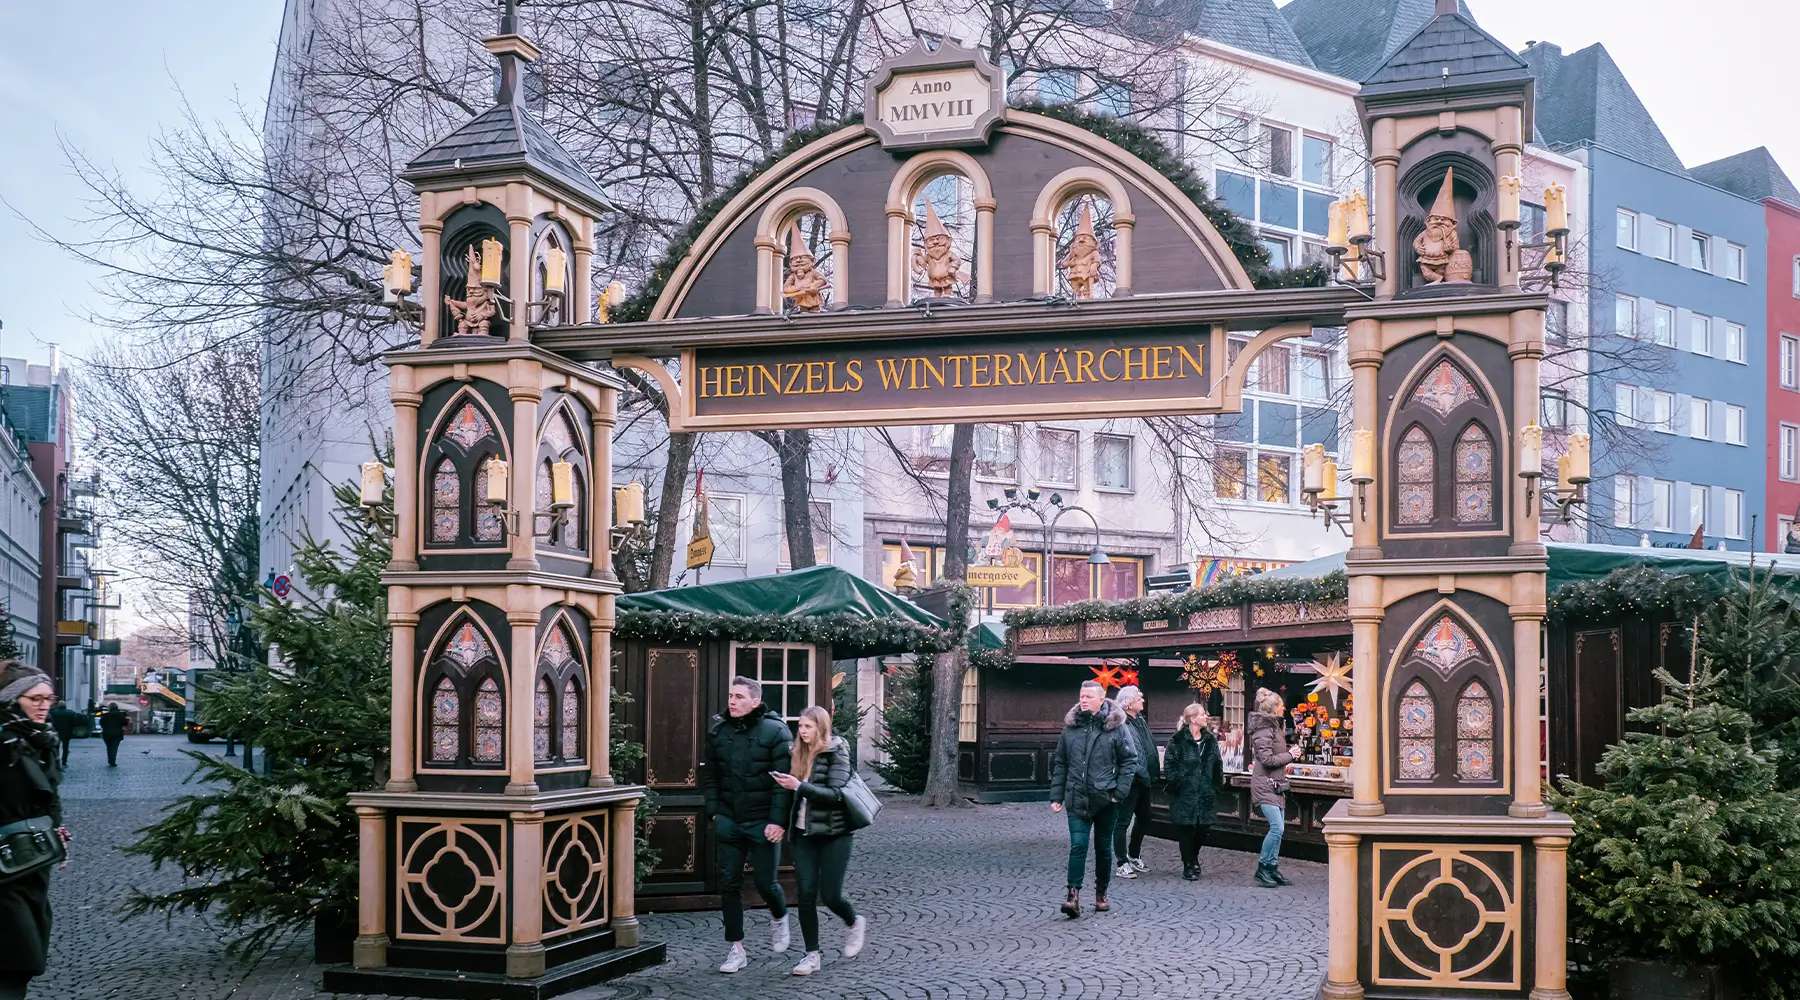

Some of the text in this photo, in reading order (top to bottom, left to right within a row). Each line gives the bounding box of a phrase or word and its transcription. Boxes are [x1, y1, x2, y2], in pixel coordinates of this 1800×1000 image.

[910, 81, 952, 95] Anno
[890, 99, 974, 122] MMVIII
[699, 343, 1206, 398] HEINZELS WINTERMÄRCHEN
